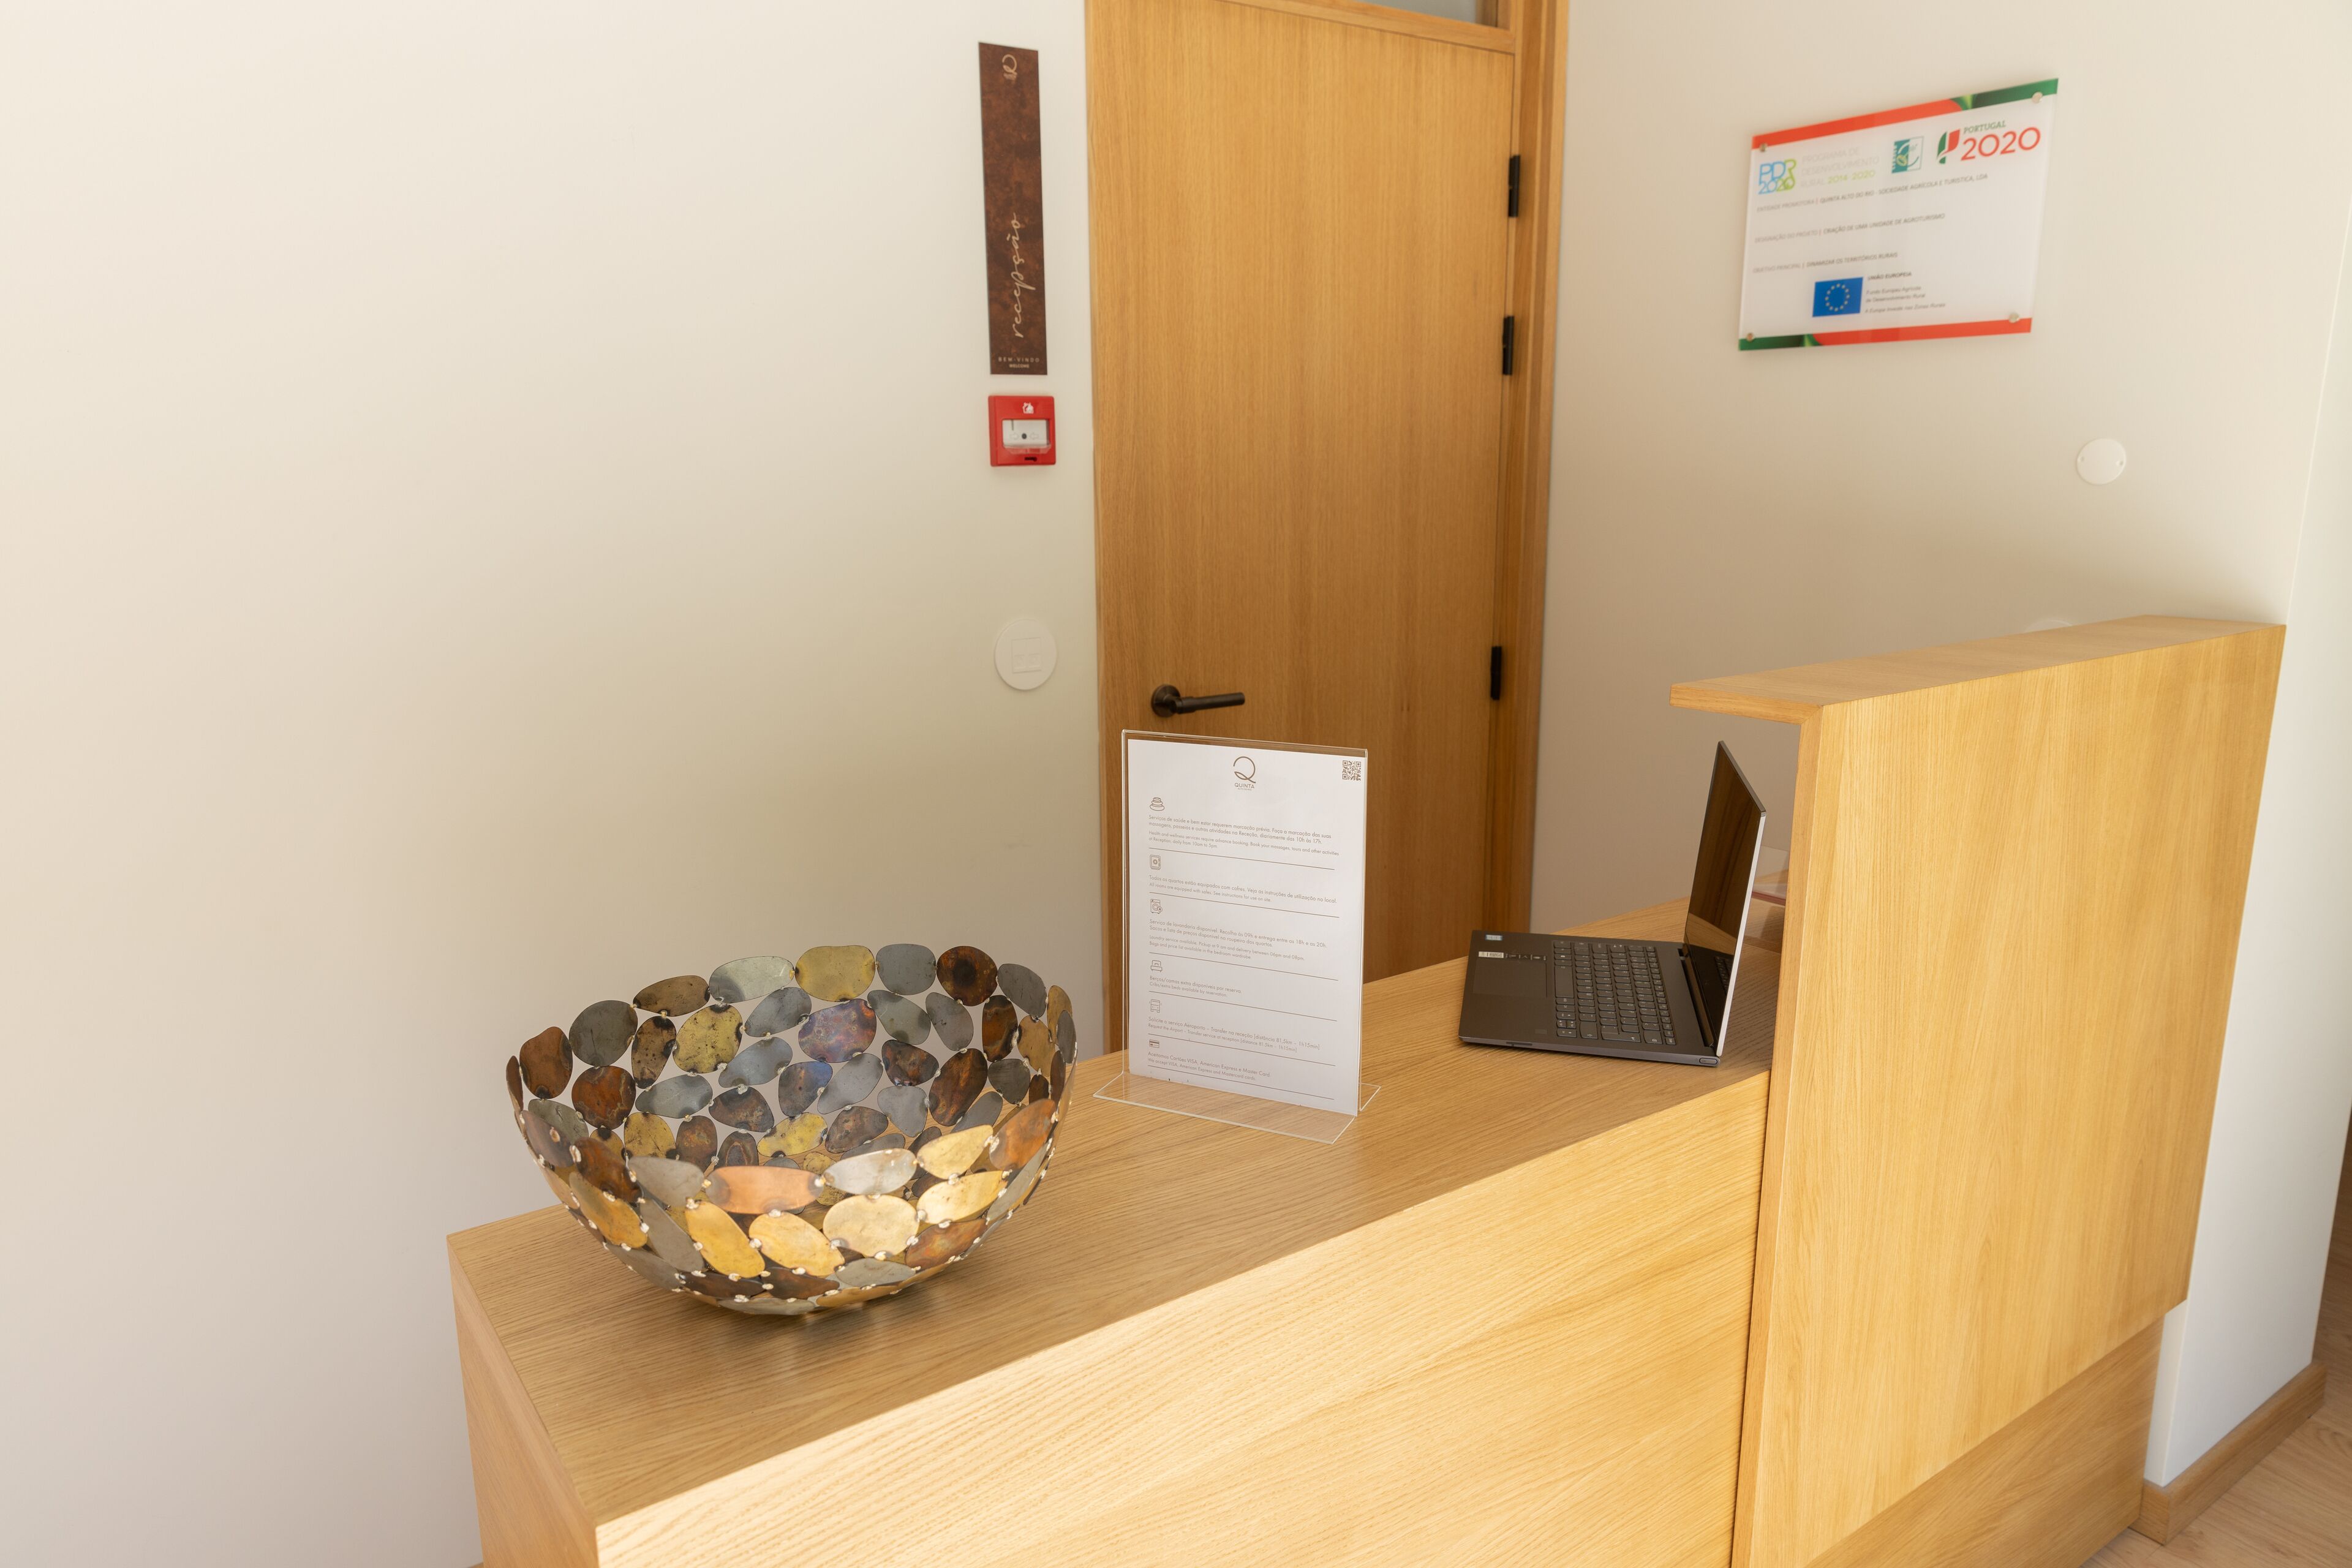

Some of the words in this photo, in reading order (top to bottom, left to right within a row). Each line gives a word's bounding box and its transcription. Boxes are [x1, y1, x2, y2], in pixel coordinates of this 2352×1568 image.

[1964, 121, 2006, 134] PORTUGAL
[1961, 127, 2041, 161] 2020
[1802, 149, 1846, 163] PROGRAMA
[1849, 147, 1858, 156] DE
[1758, 159, 1796, 186] PDR
[1802, 156, 1879, 175] DESENVOLVIMENTO
[1758, 177, 1796, 194] 2020
[1006, 212, 1036, 339] recepção
